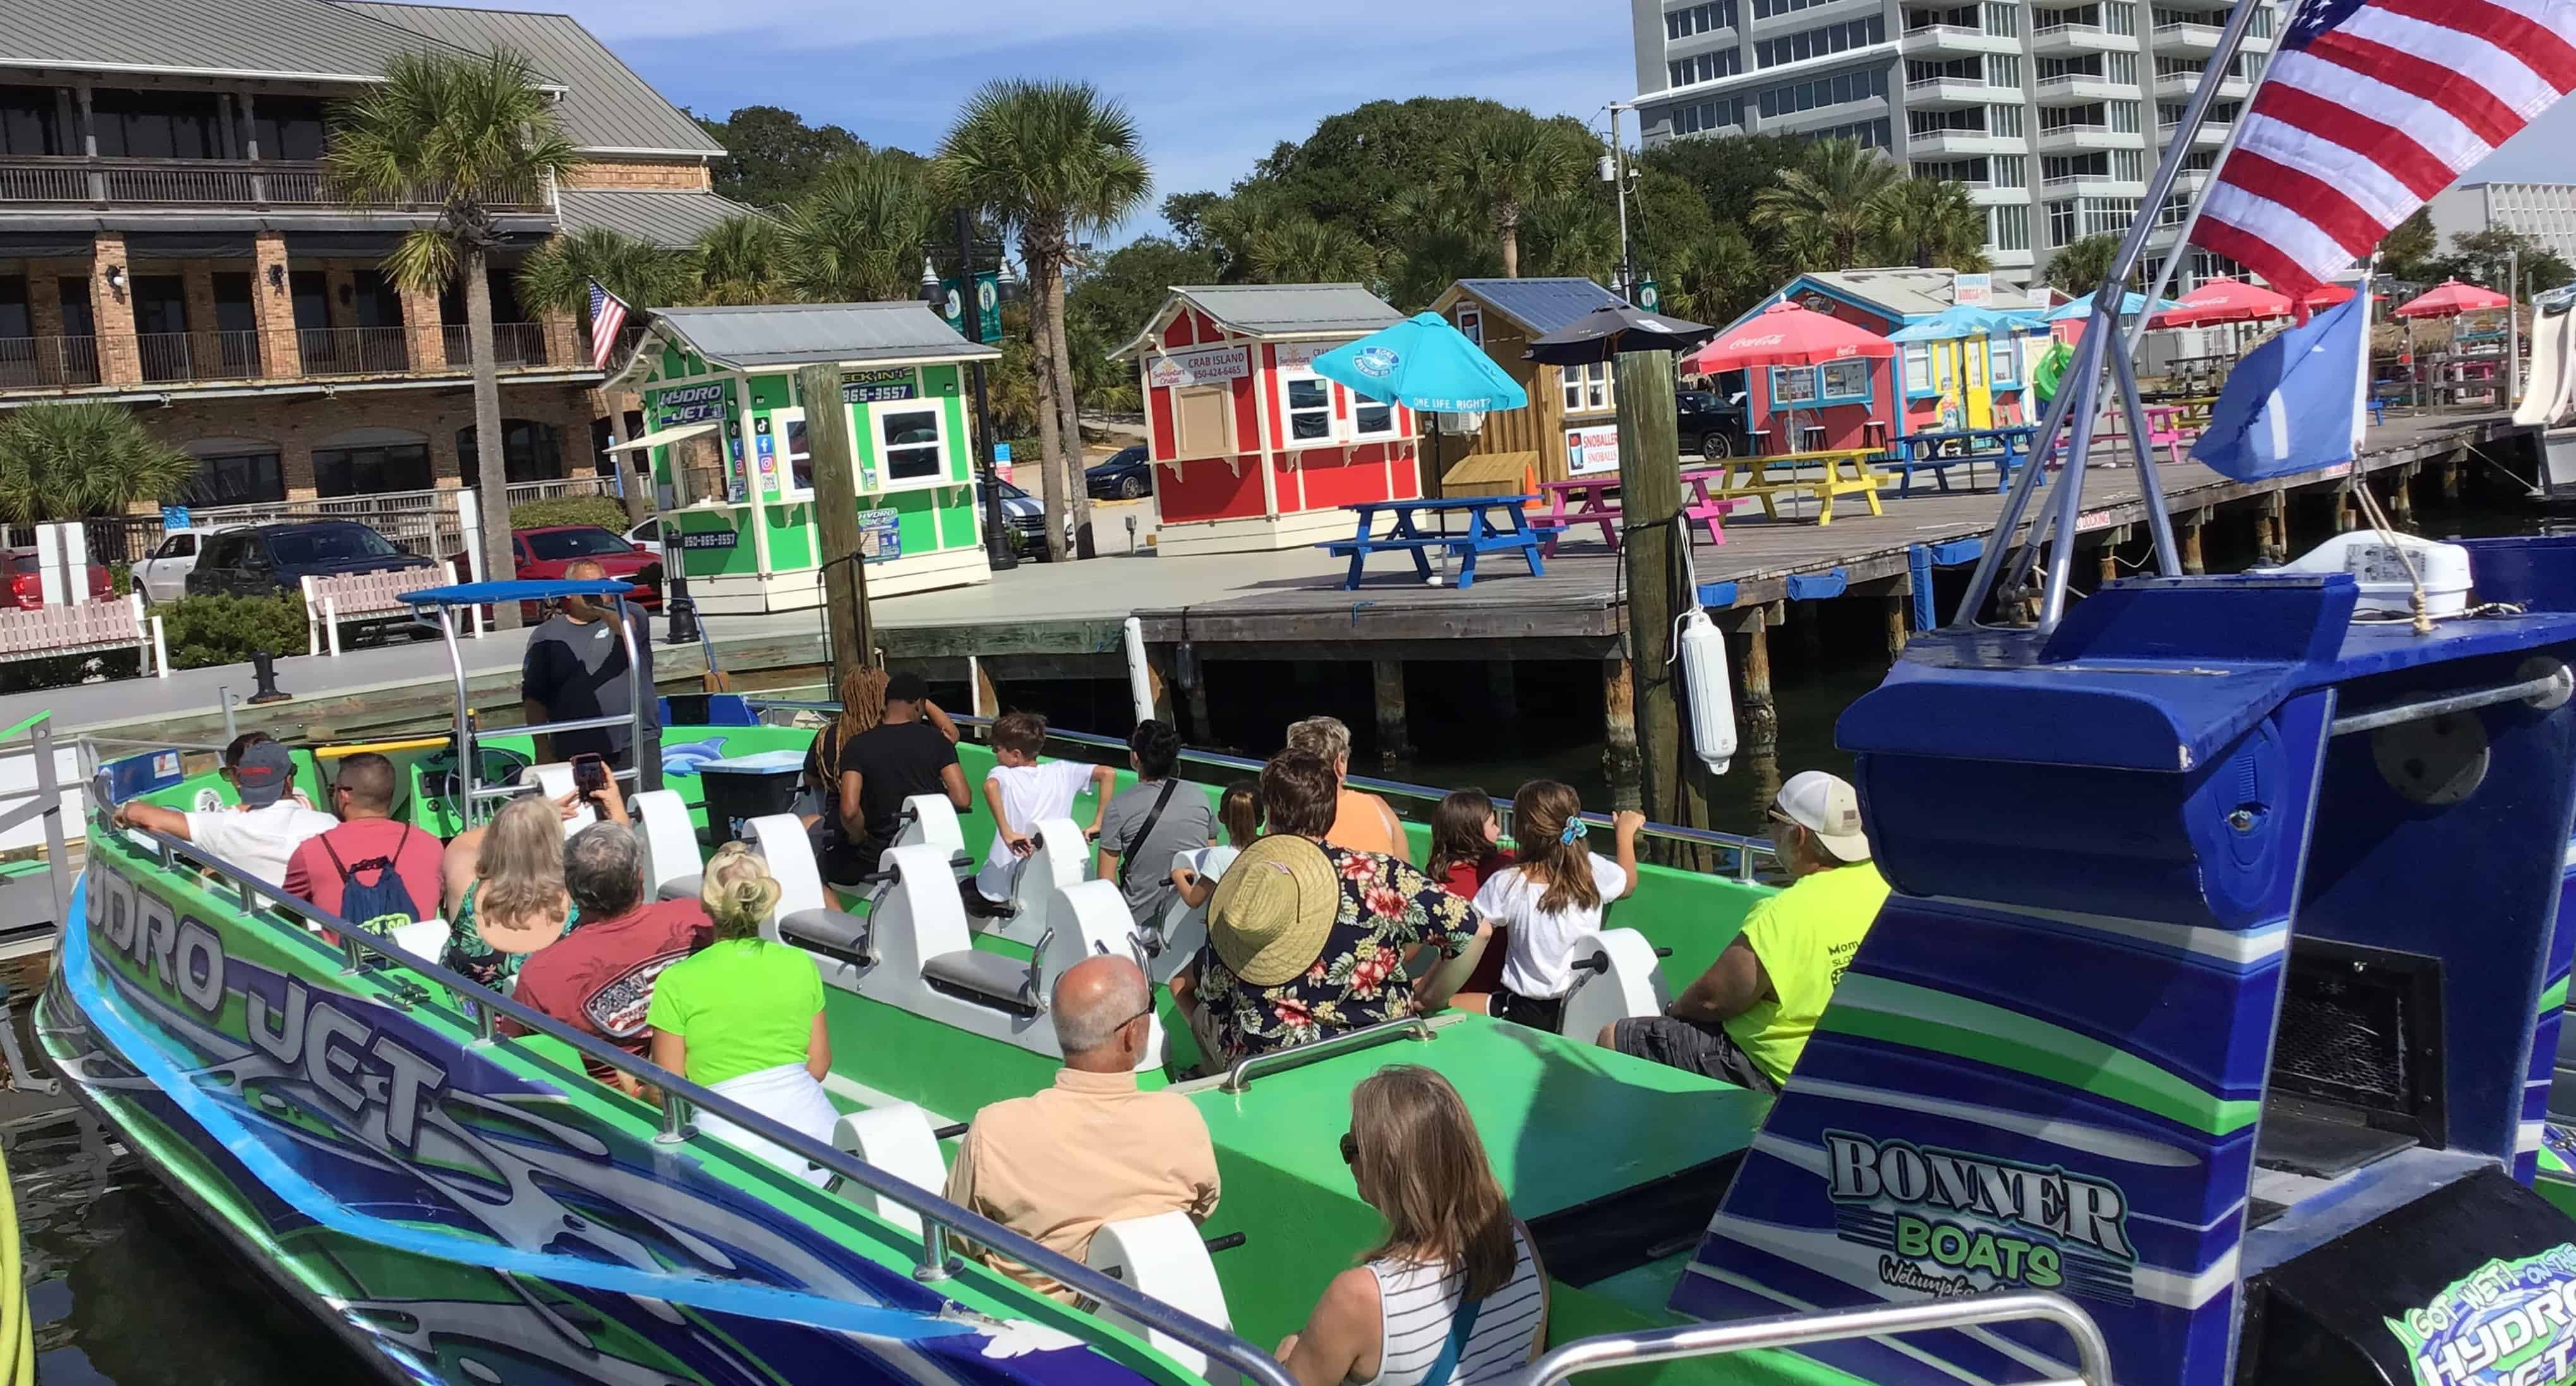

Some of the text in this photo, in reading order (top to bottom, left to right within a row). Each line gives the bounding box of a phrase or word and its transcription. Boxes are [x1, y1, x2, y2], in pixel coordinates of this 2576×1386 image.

[1729, 334, 1787, 349] Coca-Cola
[1188, 353, 1244, 368] CRAB ISLAND
[659, 384, 721, 406] HYDRO
[1413, 397, 1429, 407] ONE
[1456, 397, 1491, 410] RIGHT?
[671, 404, 708, 421] JET
[858, 510, 894, 520] HYDRO
[87, 865, 224, 1011] YDRO
[248, 981, 446, 1148] JET
[1829, 1135, 2133, 1258] BONNER
[1898, 1216, 2062, 1287] BOATS
[2410, 1295, 2459, 1339] GOT
[2458, 1262, 2519, 1311] WET!
[2526, 1259, 2553, 1284] ON
